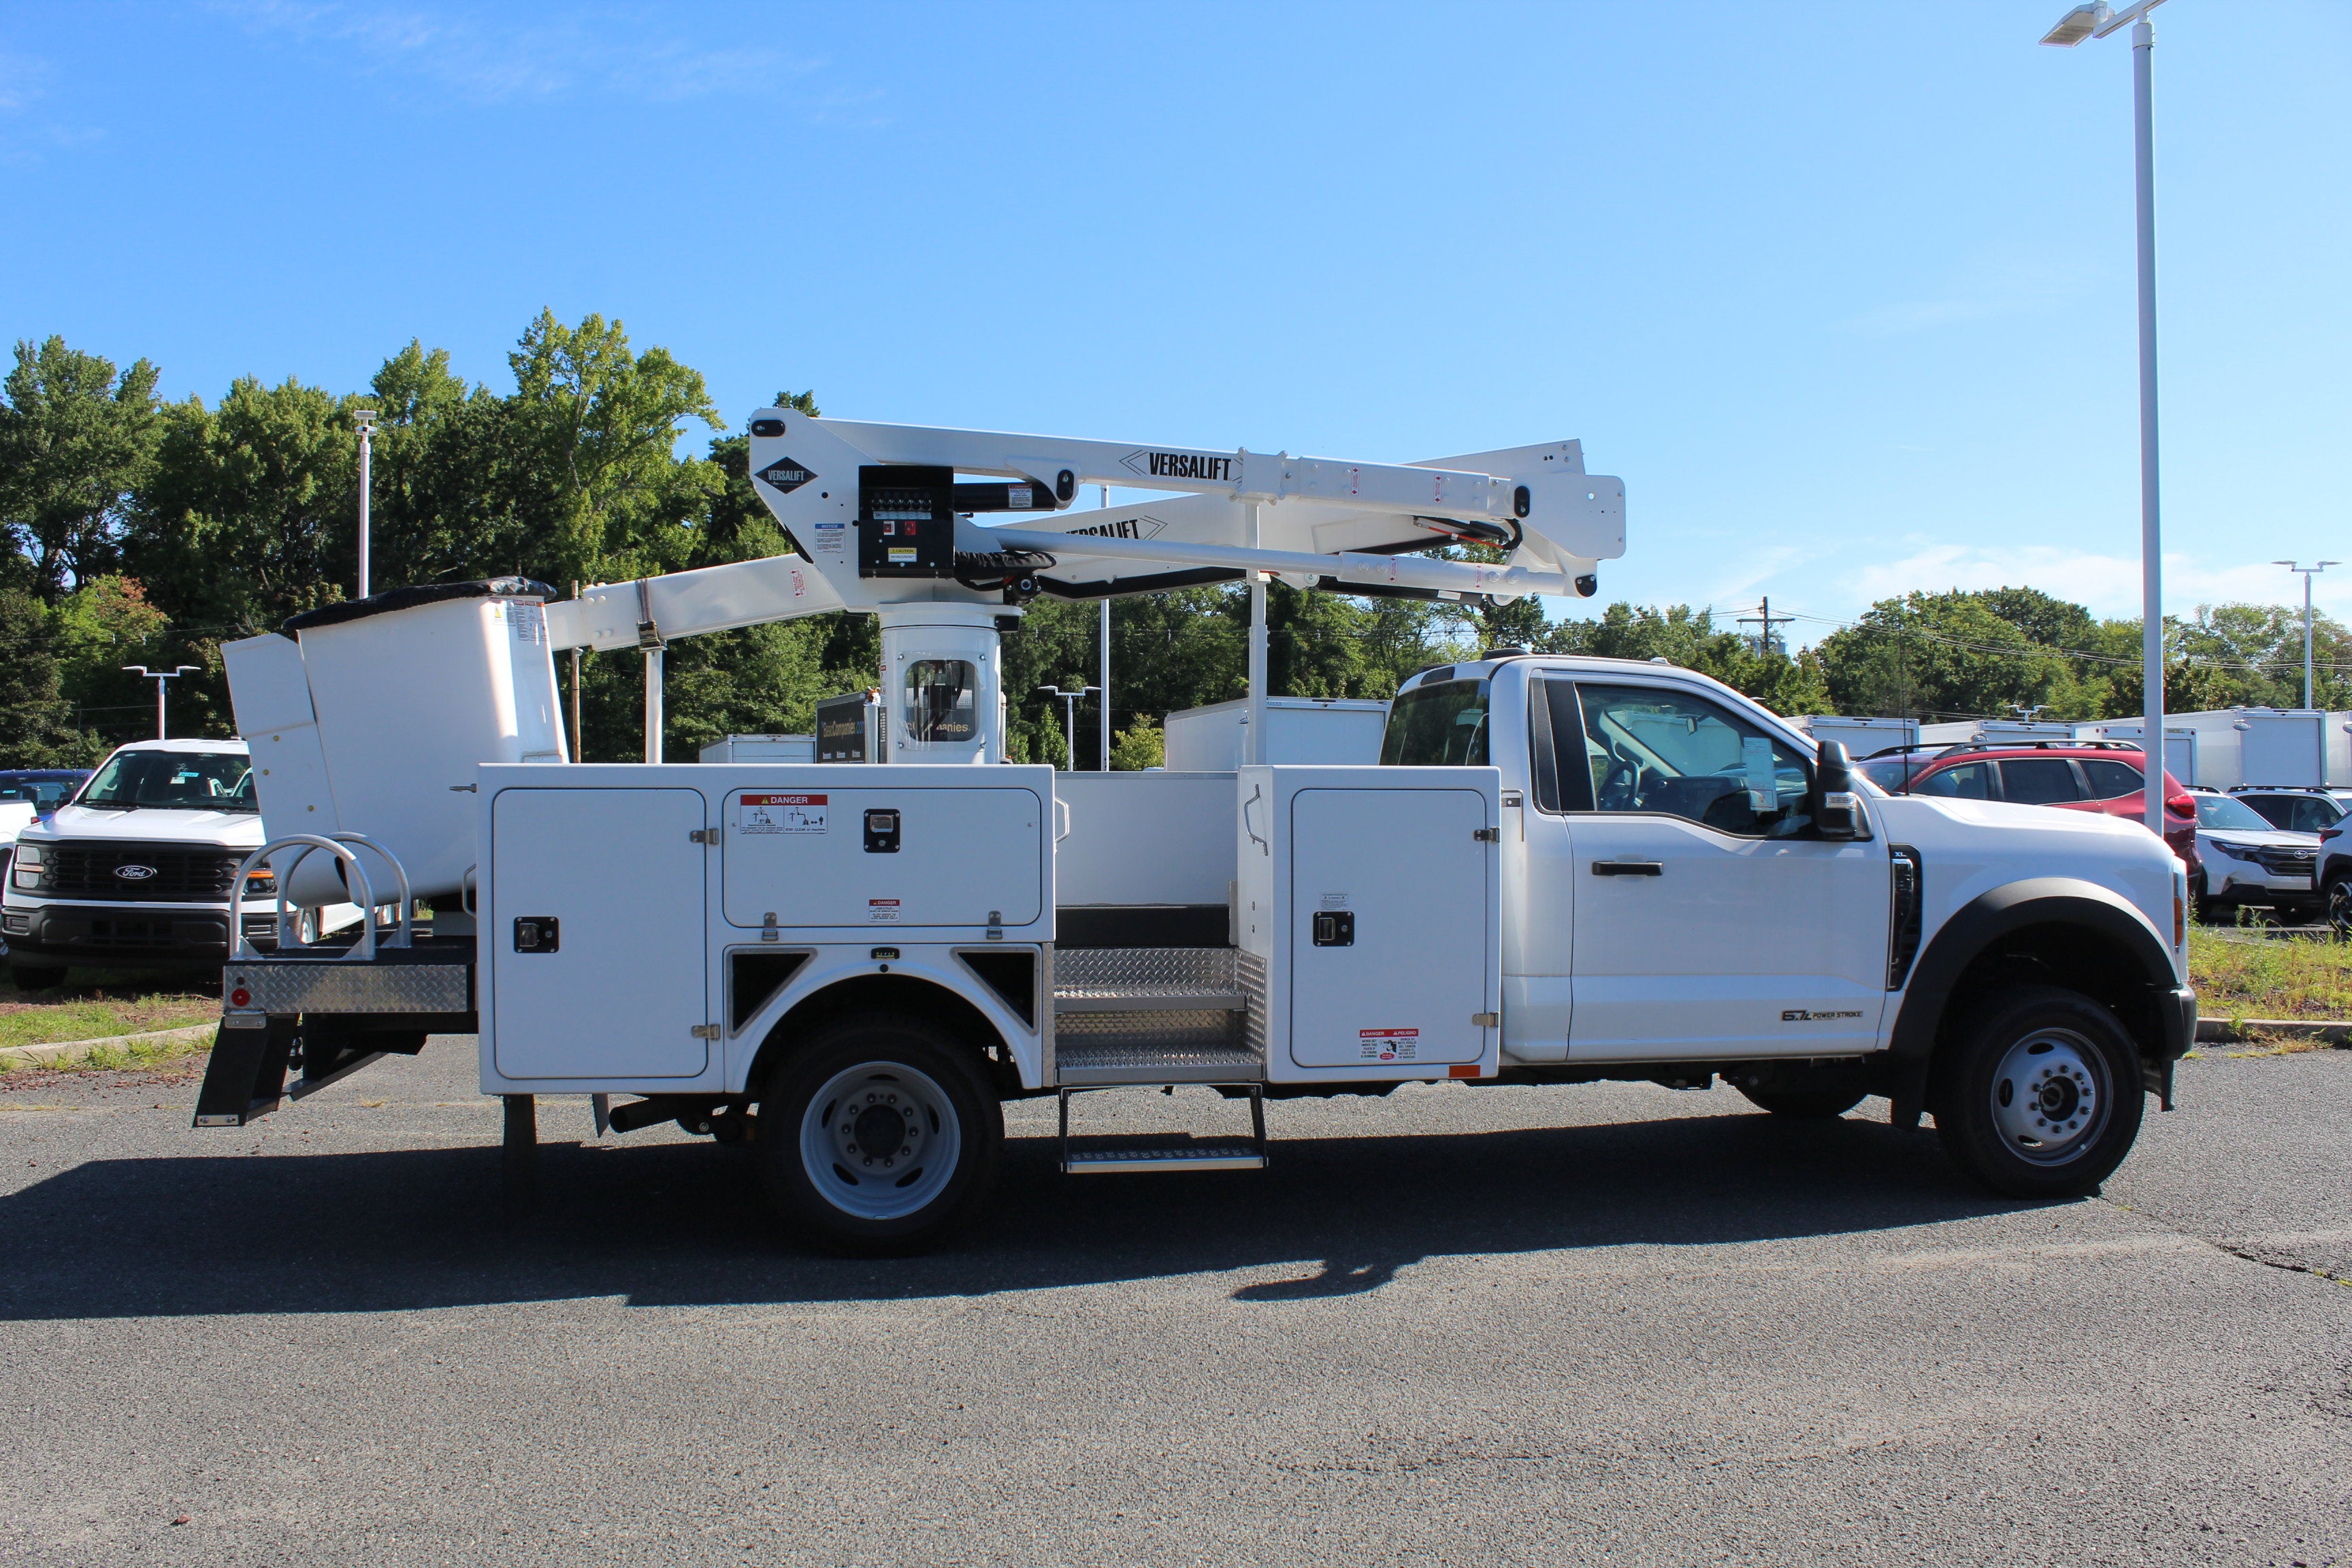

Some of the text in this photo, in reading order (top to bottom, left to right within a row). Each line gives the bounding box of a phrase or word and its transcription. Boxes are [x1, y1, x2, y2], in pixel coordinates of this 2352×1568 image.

[1149, 452, 1232, 481] VERSALIFT
[767, 470, 804, 481] VERSALIFT
[122, 867, 146, 877] Ford
